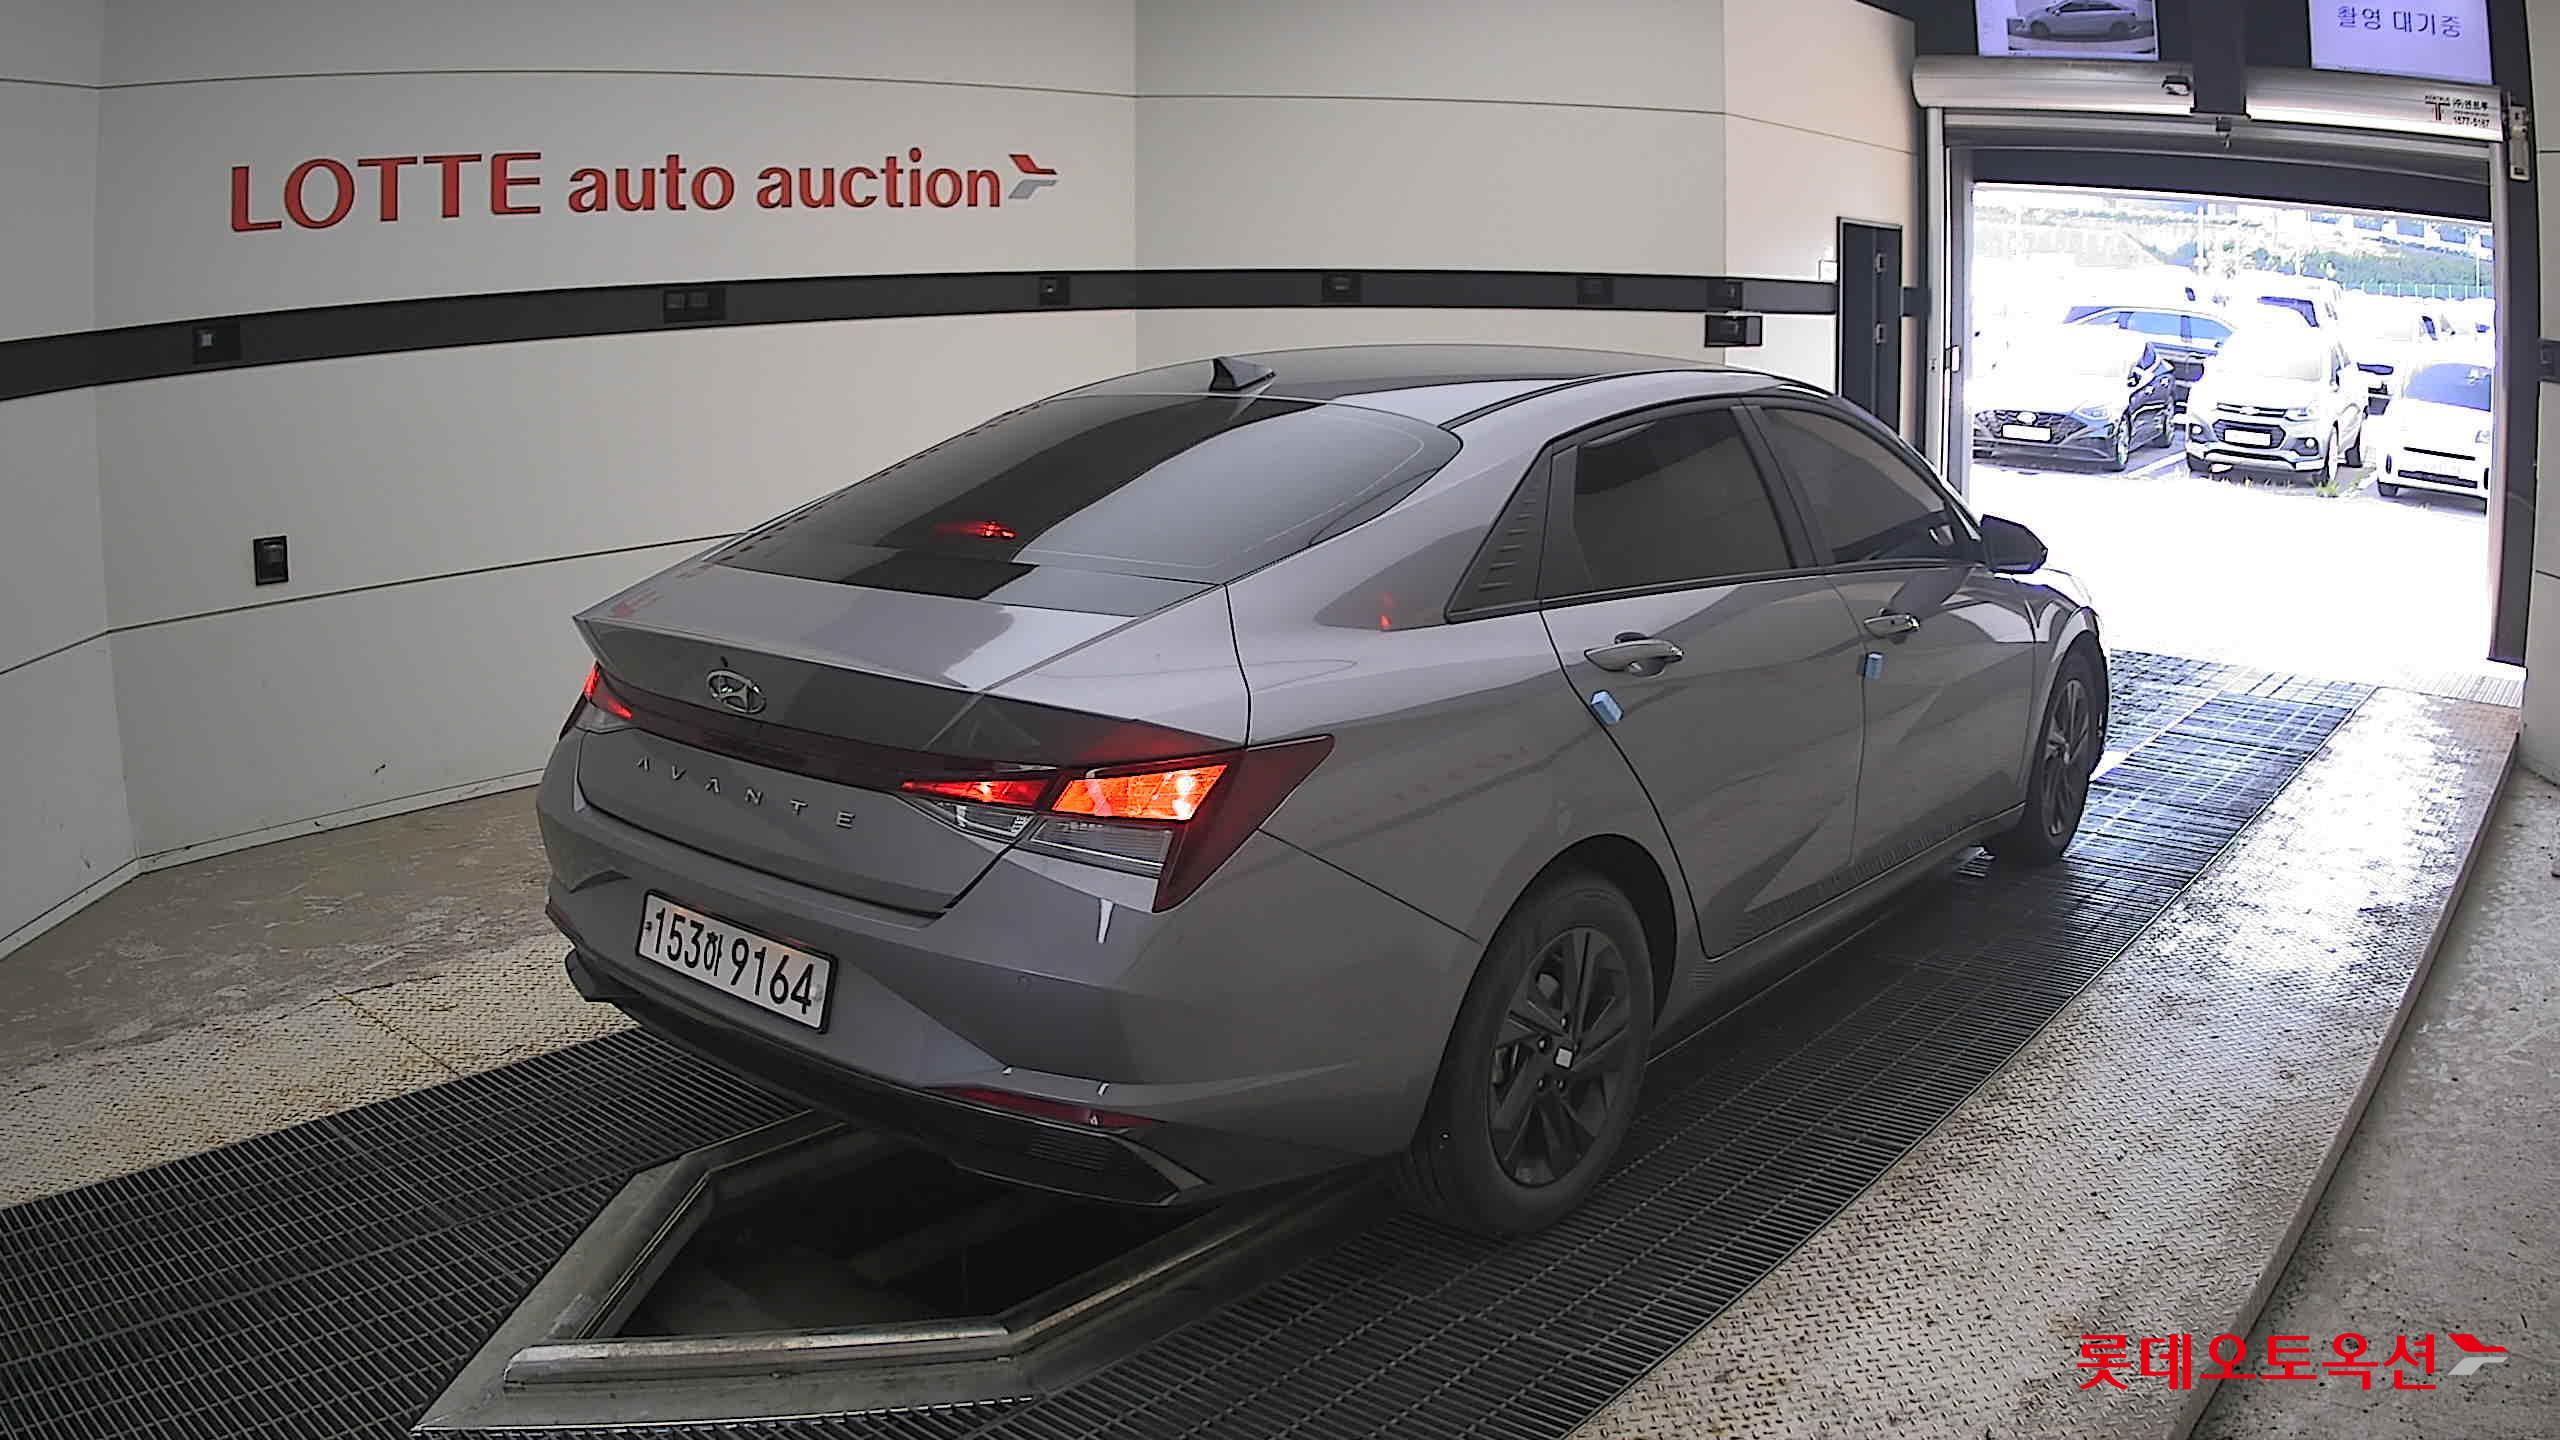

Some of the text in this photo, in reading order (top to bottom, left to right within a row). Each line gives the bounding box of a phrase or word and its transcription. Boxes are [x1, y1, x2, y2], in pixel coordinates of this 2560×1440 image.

[2337, 6, 2462, 38] 촬영 대기중
[230, 147, 1002, 233] LOTTE auto auction
[635, 754, 857, 830] AVANTE
